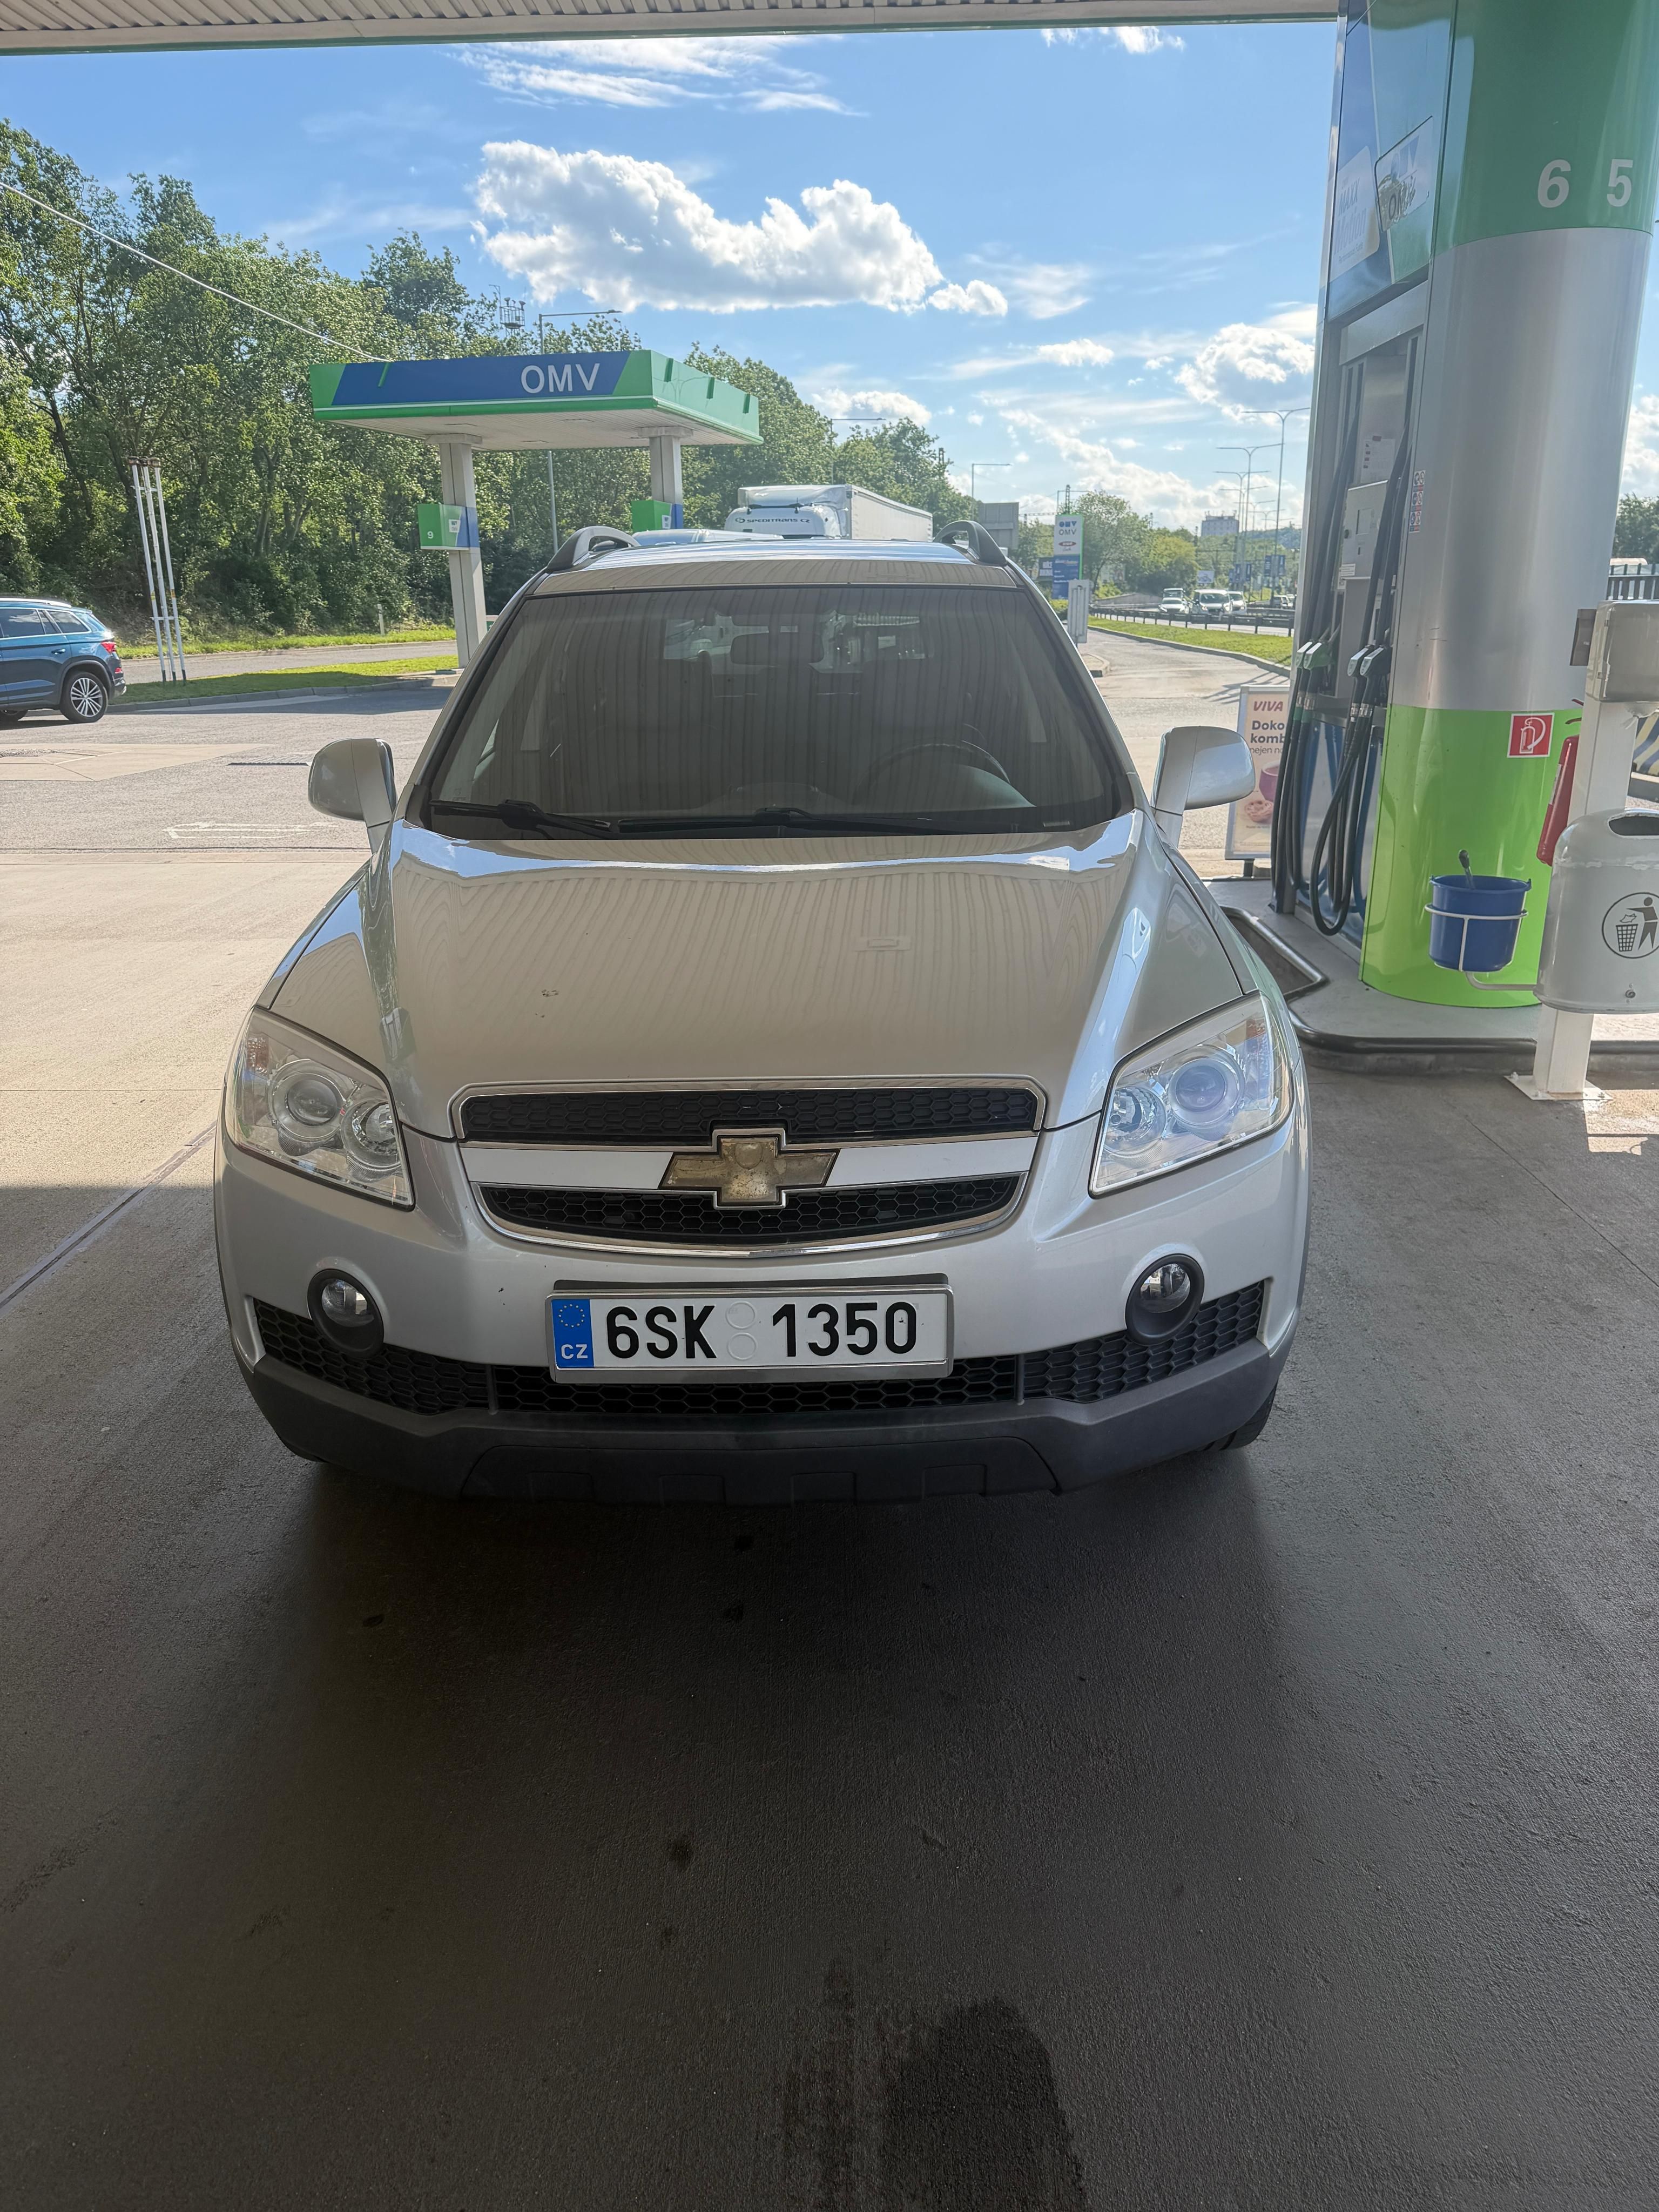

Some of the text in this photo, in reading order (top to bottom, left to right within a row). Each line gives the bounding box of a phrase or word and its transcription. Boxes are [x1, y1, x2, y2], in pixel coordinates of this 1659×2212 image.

[1537, 159, 1634, 208] 6 5
[521, 363, 601, 394] OMV
[427, 531, 434, 539] 9
[1253, 701, 1284, 711] VIVA
[1252, 720, 1285, 730] Doko
[1250, 746, 1272, 756] nejen
[606, 1301, 916, 1359] 6SK 1350
[561, 1344, 588, 1359] CZ
